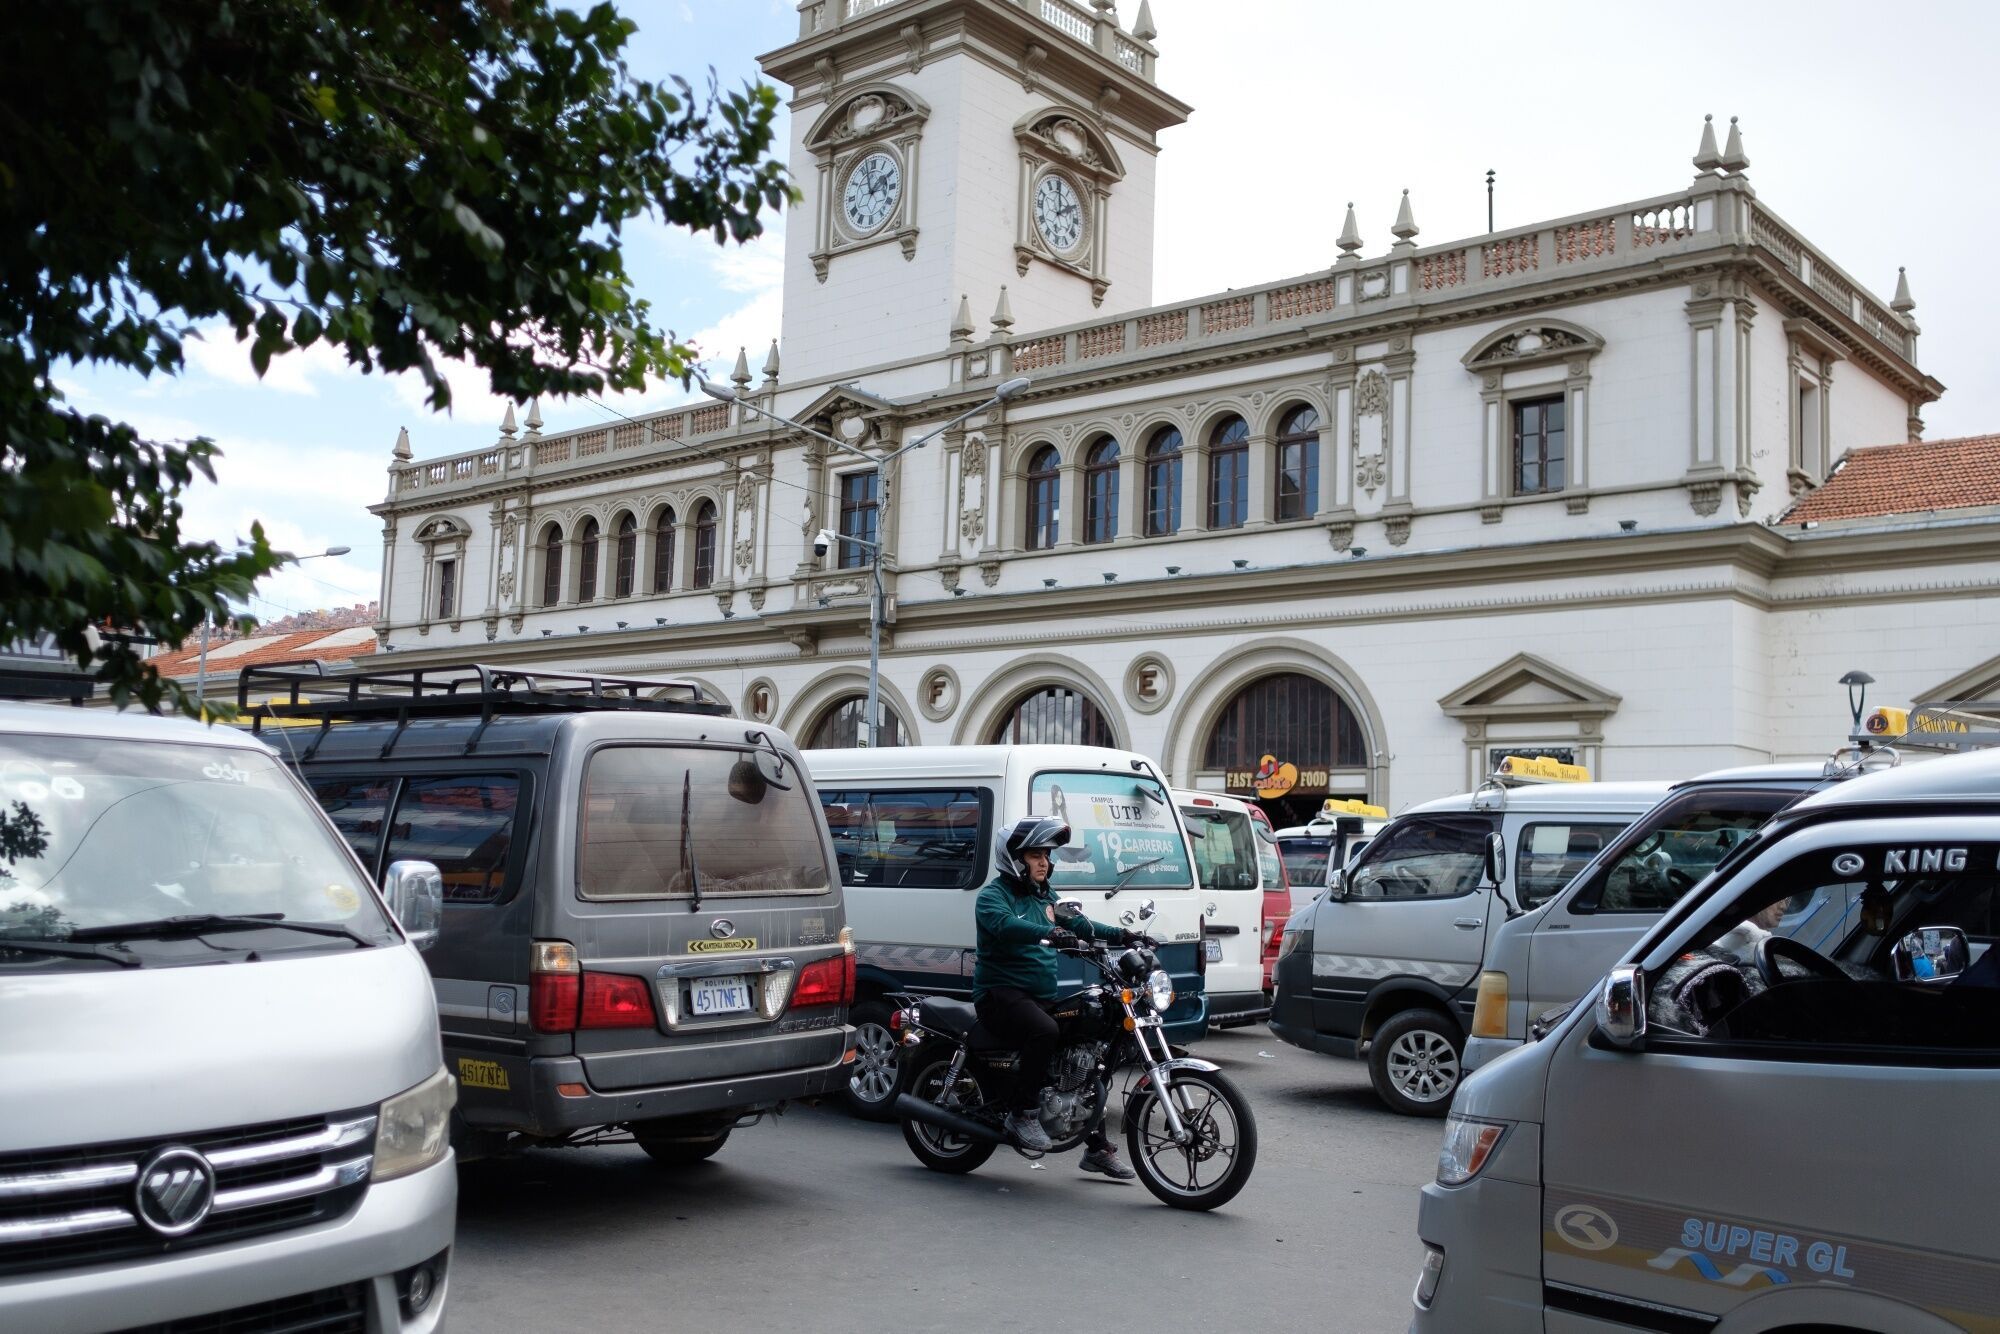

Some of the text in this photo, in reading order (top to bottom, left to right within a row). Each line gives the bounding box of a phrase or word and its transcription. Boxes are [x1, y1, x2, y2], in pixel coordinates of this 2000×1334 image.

[753, 669, 1158, 714] N F E
[1226, 772, 1253, 788] FAST
[1300, 770, 1328, 787] FOOD
[1090, 796, 1114, 804] CAMPUS
[1108, 805, 1143, 820] UTB
[1096, 831, 1174, 863] 19 CARRERAS
[1884, 848, 1968, 873] KING
[704, 978, 733, 987] BOLIVIA
[696, 987, 746, 1011] 4517NFI
[1681, 1217, 1855, 1278] SUPER GL
